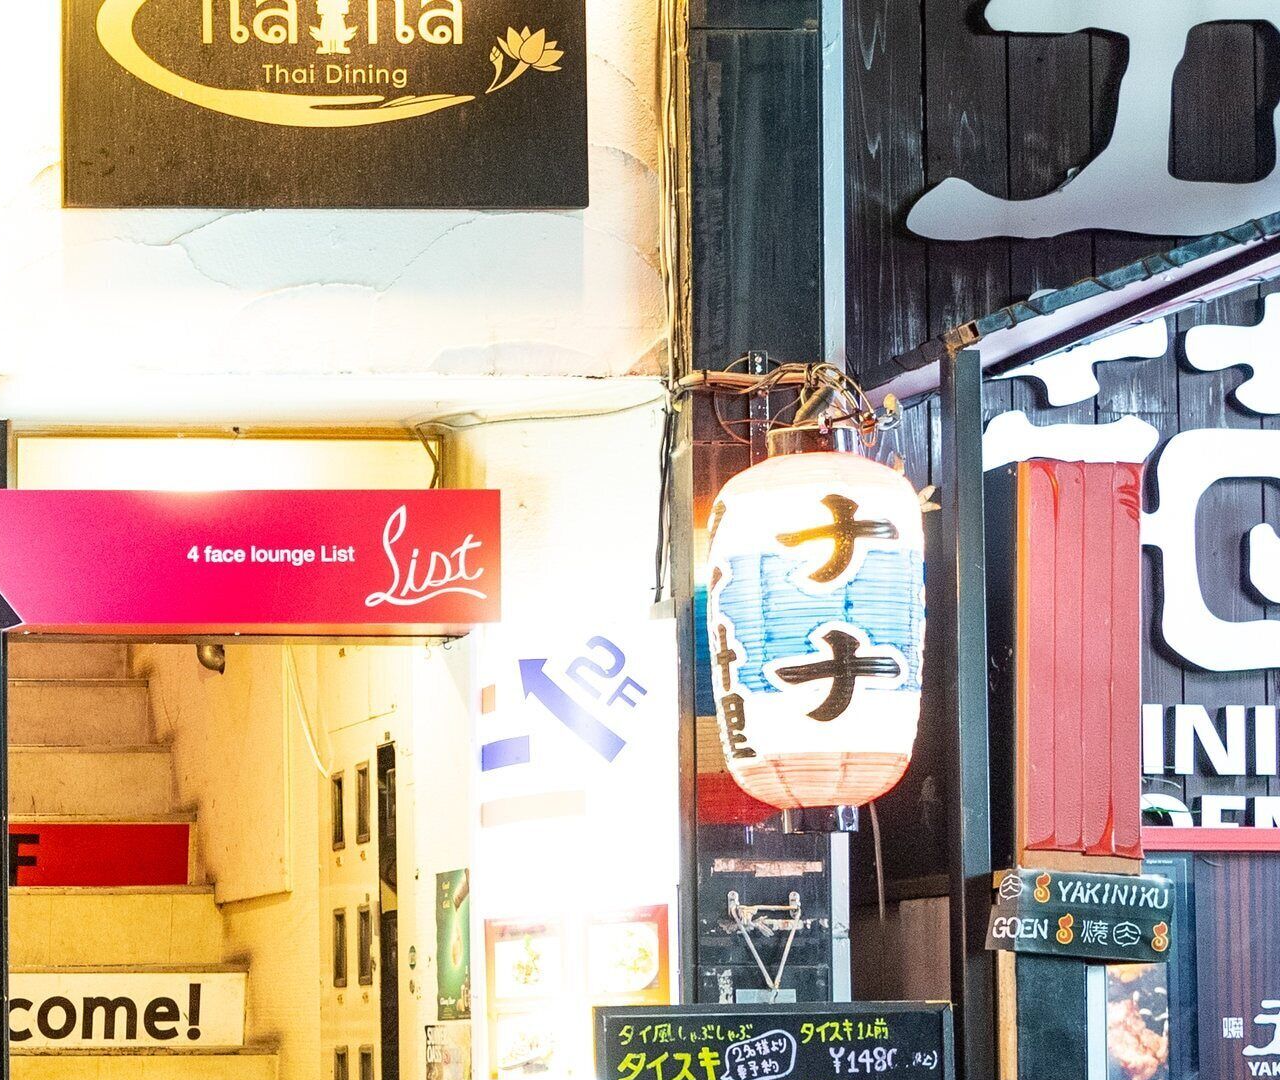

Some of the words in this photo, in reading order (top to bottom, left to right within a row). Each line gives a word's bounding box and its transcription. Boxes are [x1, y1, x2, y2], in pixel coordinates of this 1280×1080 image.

[262, 64, 315, 84] Thai
[326, 64, 408, 88] Dining
[187, 546, 199, 562] 4
[204, 546, 246, 562] face
[251, 546, 315, 566] lounge
[321, 546, 355, 562] List
[1057, 880, 1169, 910] YAKINIKU
[992, 916, 1049, 940] GOEN
